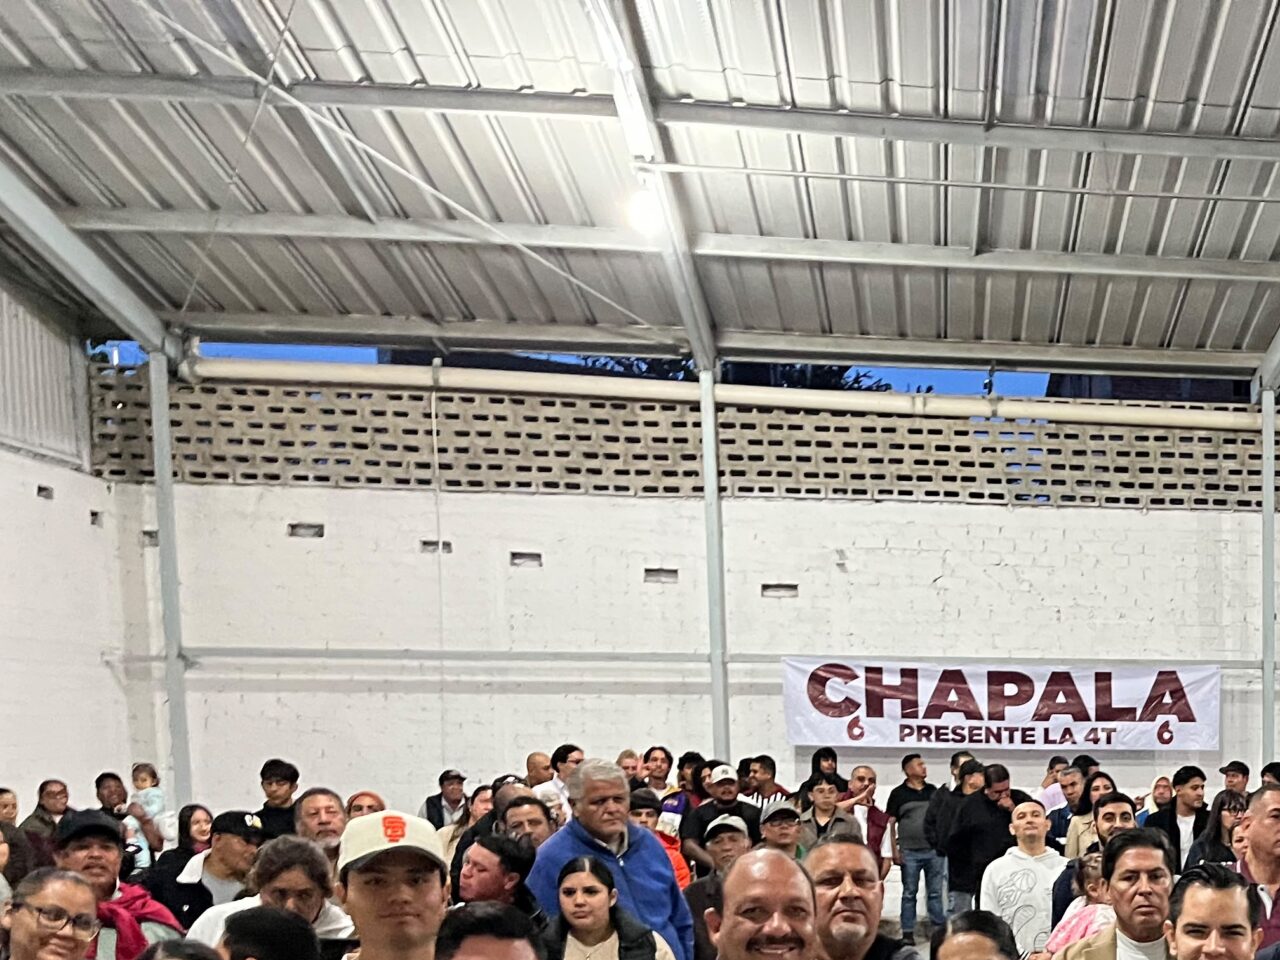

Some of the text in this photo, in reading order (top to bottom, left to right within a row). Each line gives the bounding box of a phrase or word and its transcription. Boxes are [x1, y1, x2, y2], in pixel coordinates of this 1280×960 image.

[807, 663, 1196, 722] CHAPALA
[847, 715, 865, 741] 6
[899, 724, 1117, 745] PRESENTE LA 4T
[1157, 720, 1174, 745] 6
